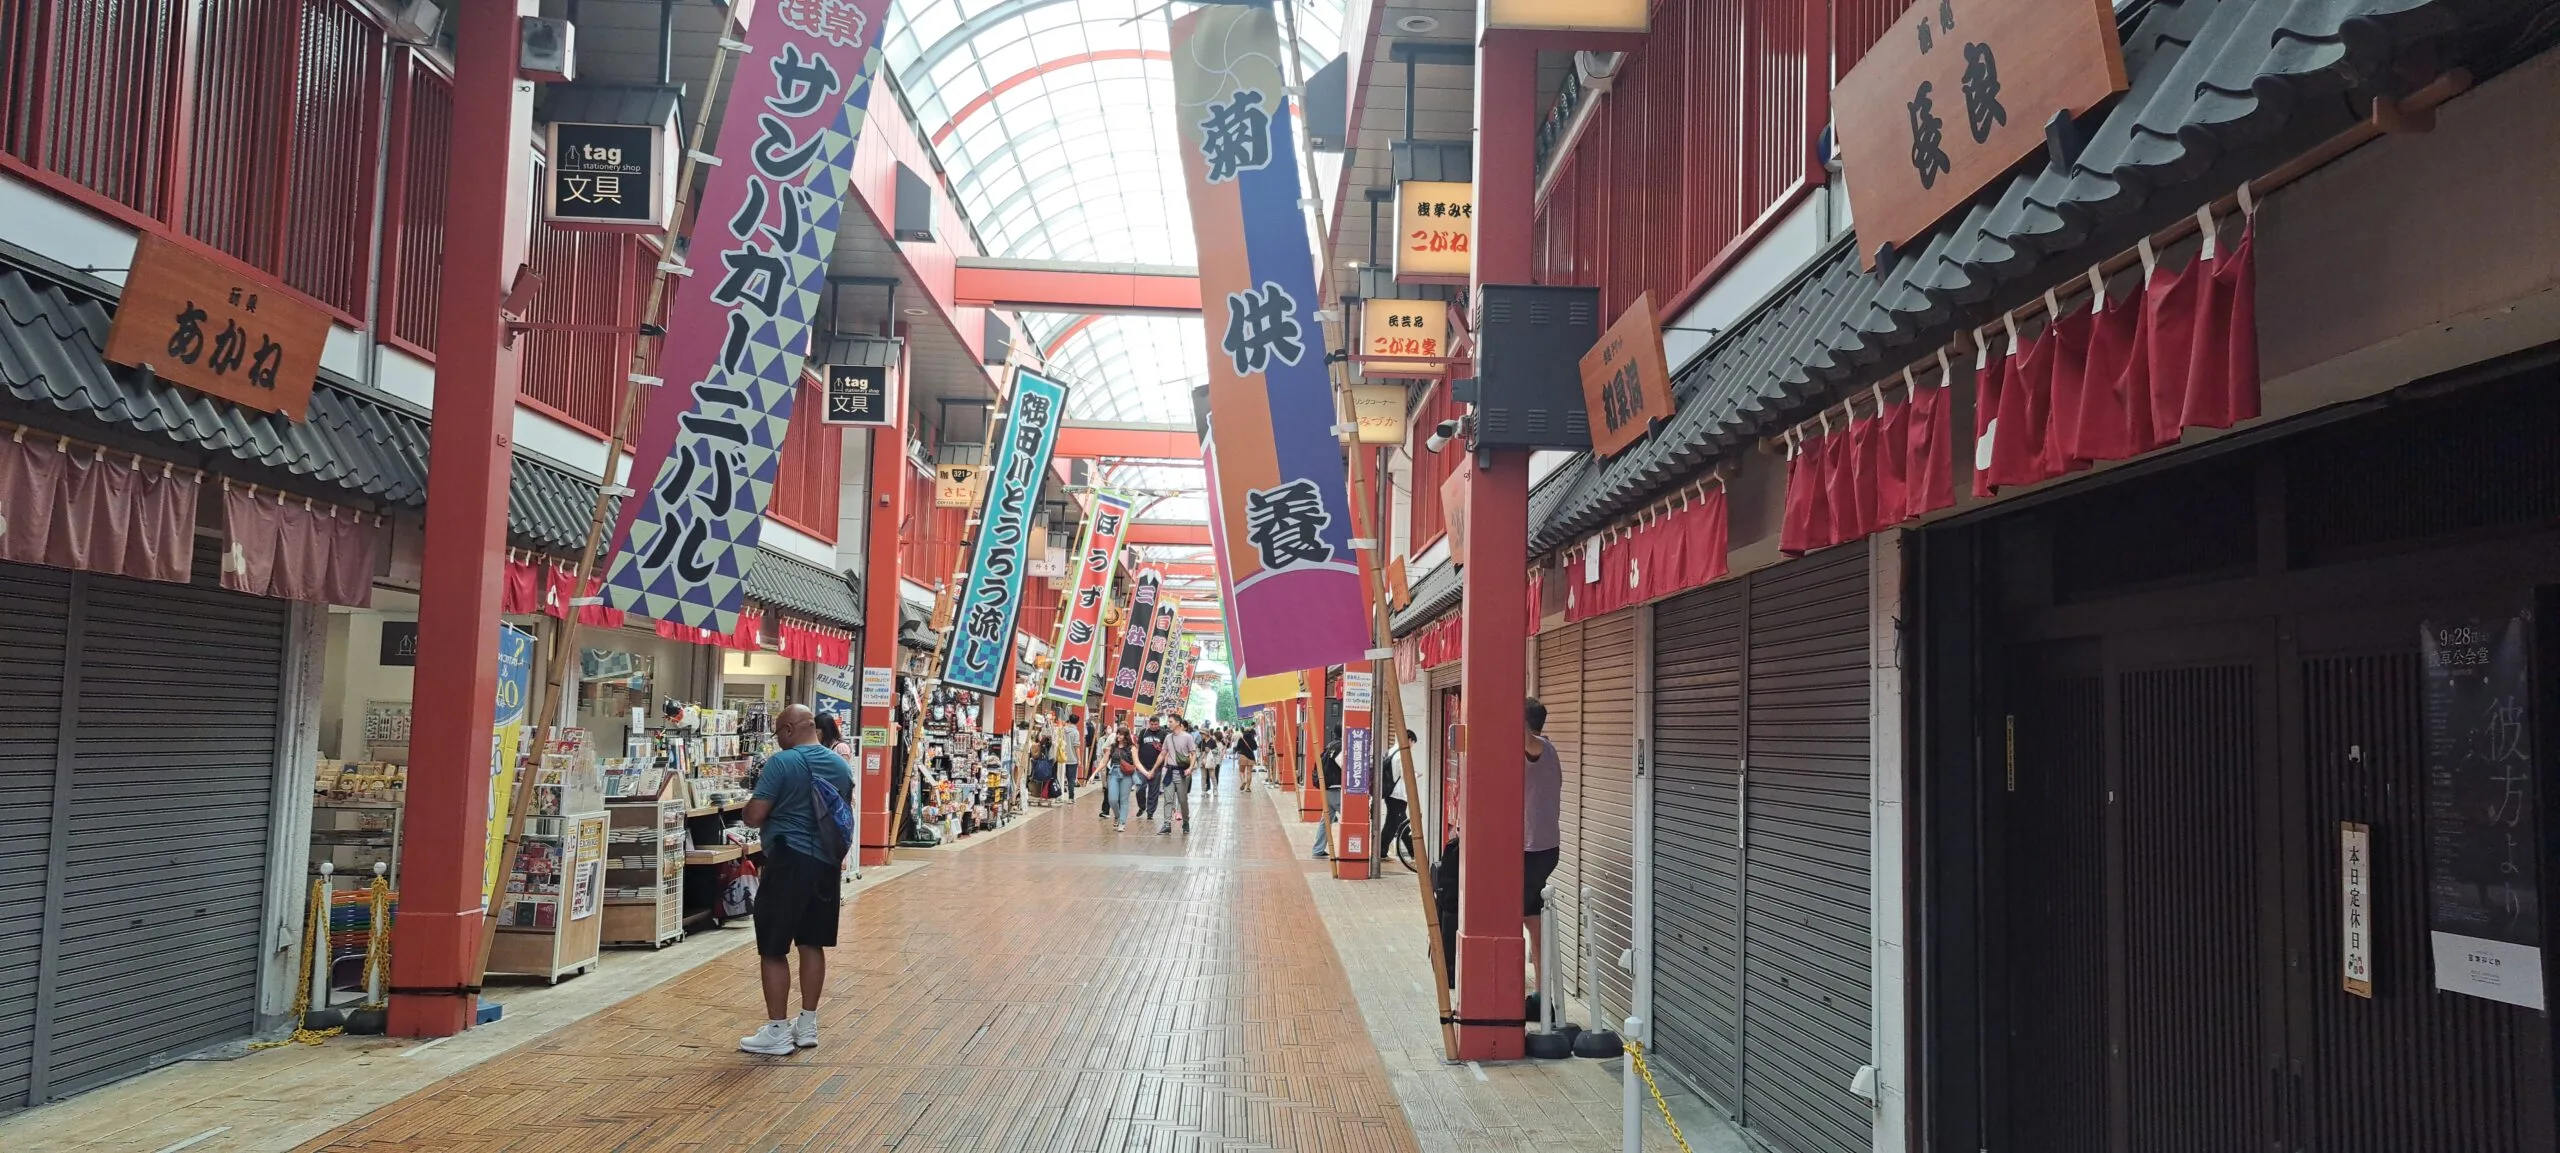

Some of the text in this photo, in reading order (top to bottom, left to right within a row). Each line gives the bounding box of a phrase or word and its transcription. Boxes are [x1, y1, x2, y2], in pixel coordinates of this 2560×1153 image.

[583, 162, 641, 173] stationery shop
[584, 144, 622, 164] tag
[563, 174, 622, 205] 文具
[641, 44, 838, 585] サンバカーニバル
[1200, 90, 1330, 569] 菊供養
[167, 300, 283, 391] あかね
[845, 376, 868, 390] tag
[833, 395, 868, 413] 文具
[1358, 416, 1398, 427] みづか
[953, 470, 965, 478] 321
[964, 392, 1051, 673] 隅田川とうろう流し
[1115, 585, 1156, 689] 三社祭
[2348, 845, 2361, 949] 本日定休日
